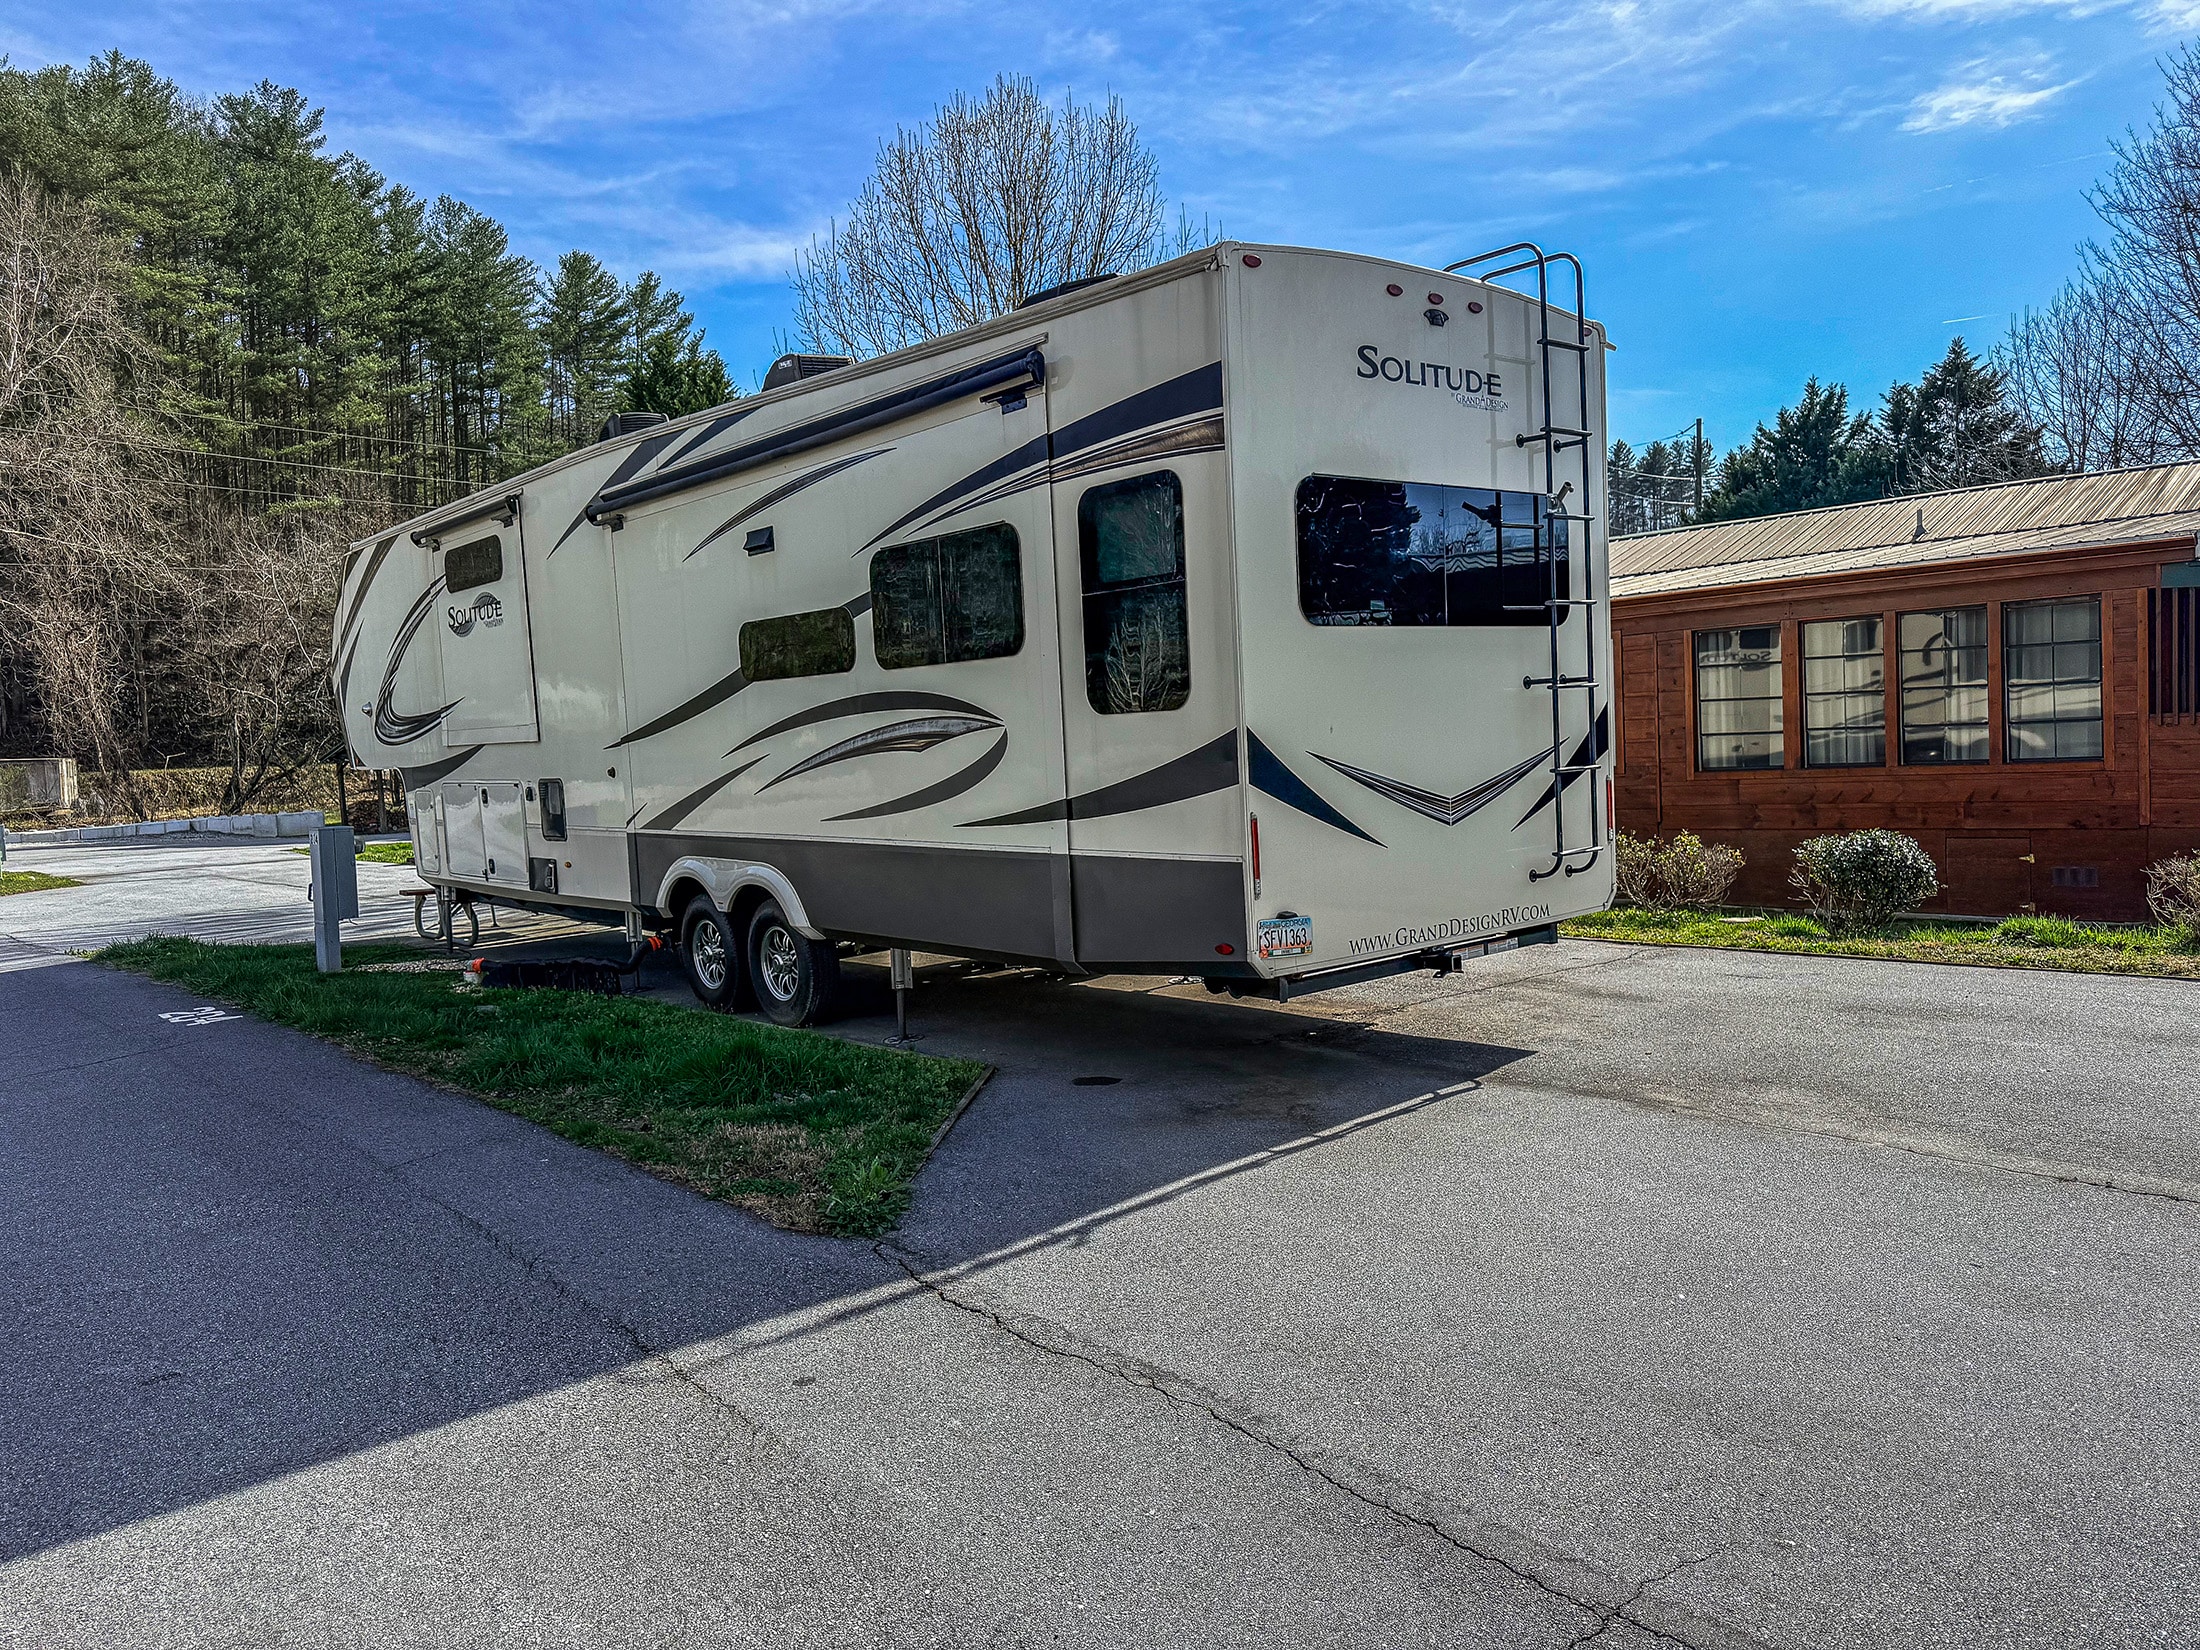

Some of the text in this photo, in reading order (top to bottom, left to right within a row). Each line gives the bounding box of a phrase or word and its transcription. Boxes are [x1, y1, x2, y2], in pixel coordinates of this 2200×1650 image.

[1357, 345, 1502, 397] SOLITUDE
[448, 600, 503, 627] SOLITUDE
[1263, 927, 1307, 949] SFV1363
